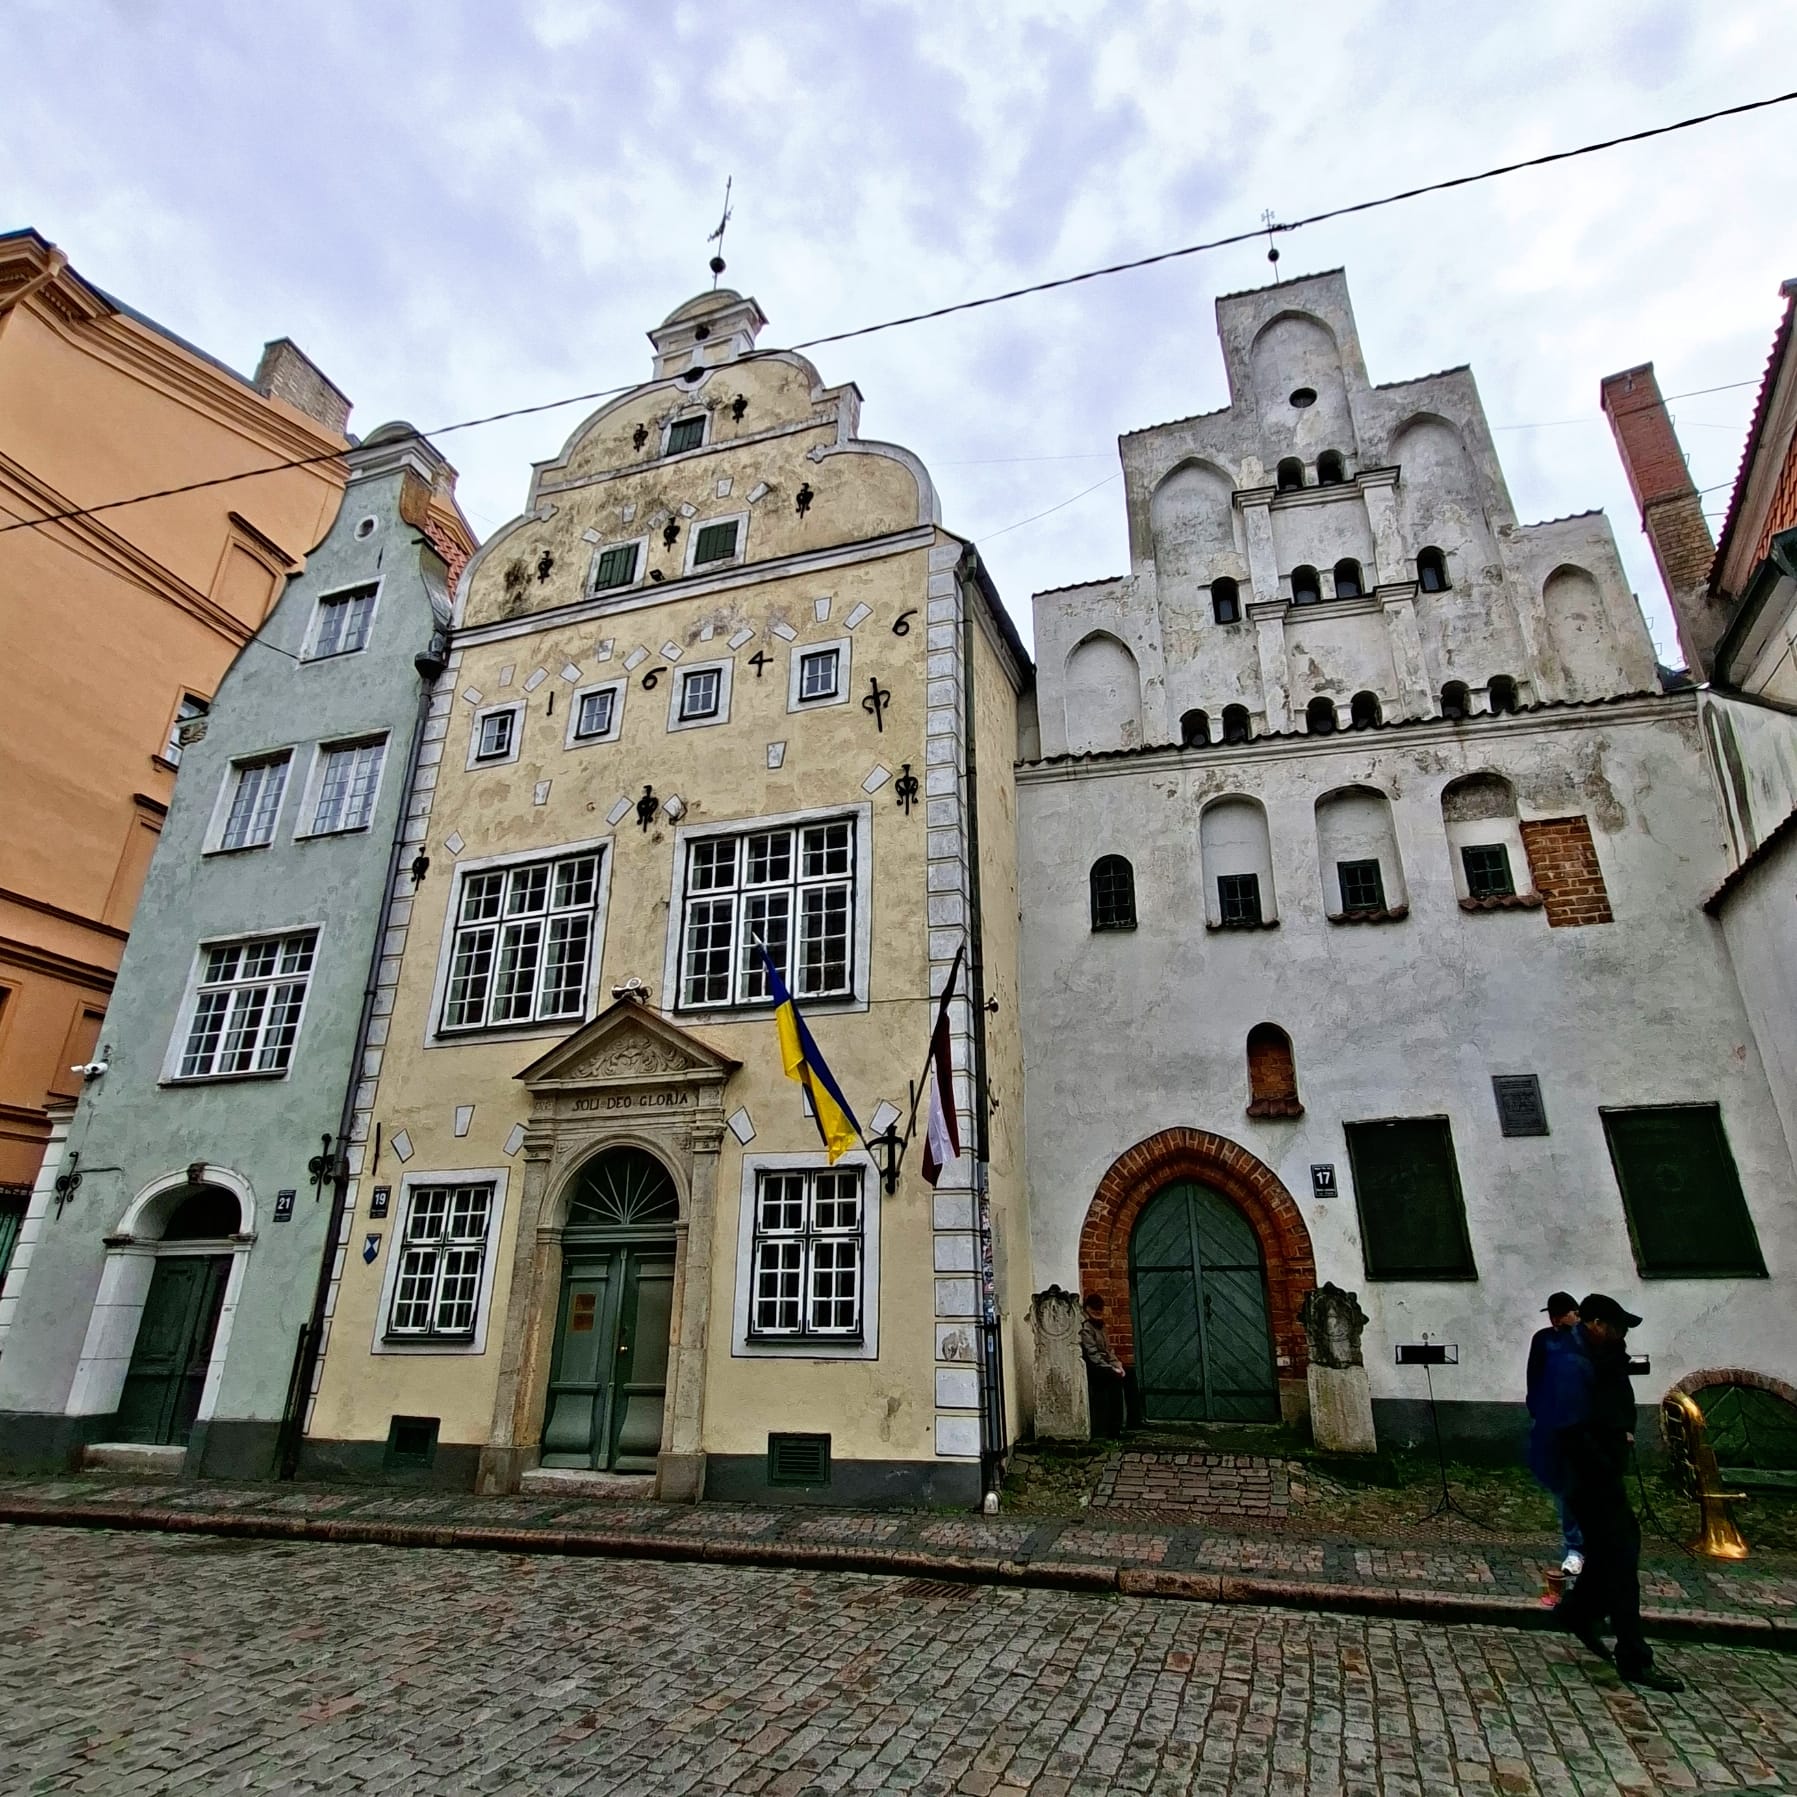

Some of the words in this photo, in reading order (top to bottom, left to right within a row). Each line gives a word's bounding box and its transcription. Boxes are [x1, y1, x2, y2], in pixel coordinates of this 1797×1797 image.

[607, 1096, 632, 1110] DEO
[639, 1092, 688, 1106] GLORIA
[1316, 1171, 1330, 1184] 17
[277, 1197, 291, 1209] 21
[375, 1193, 386, 1205] 19
